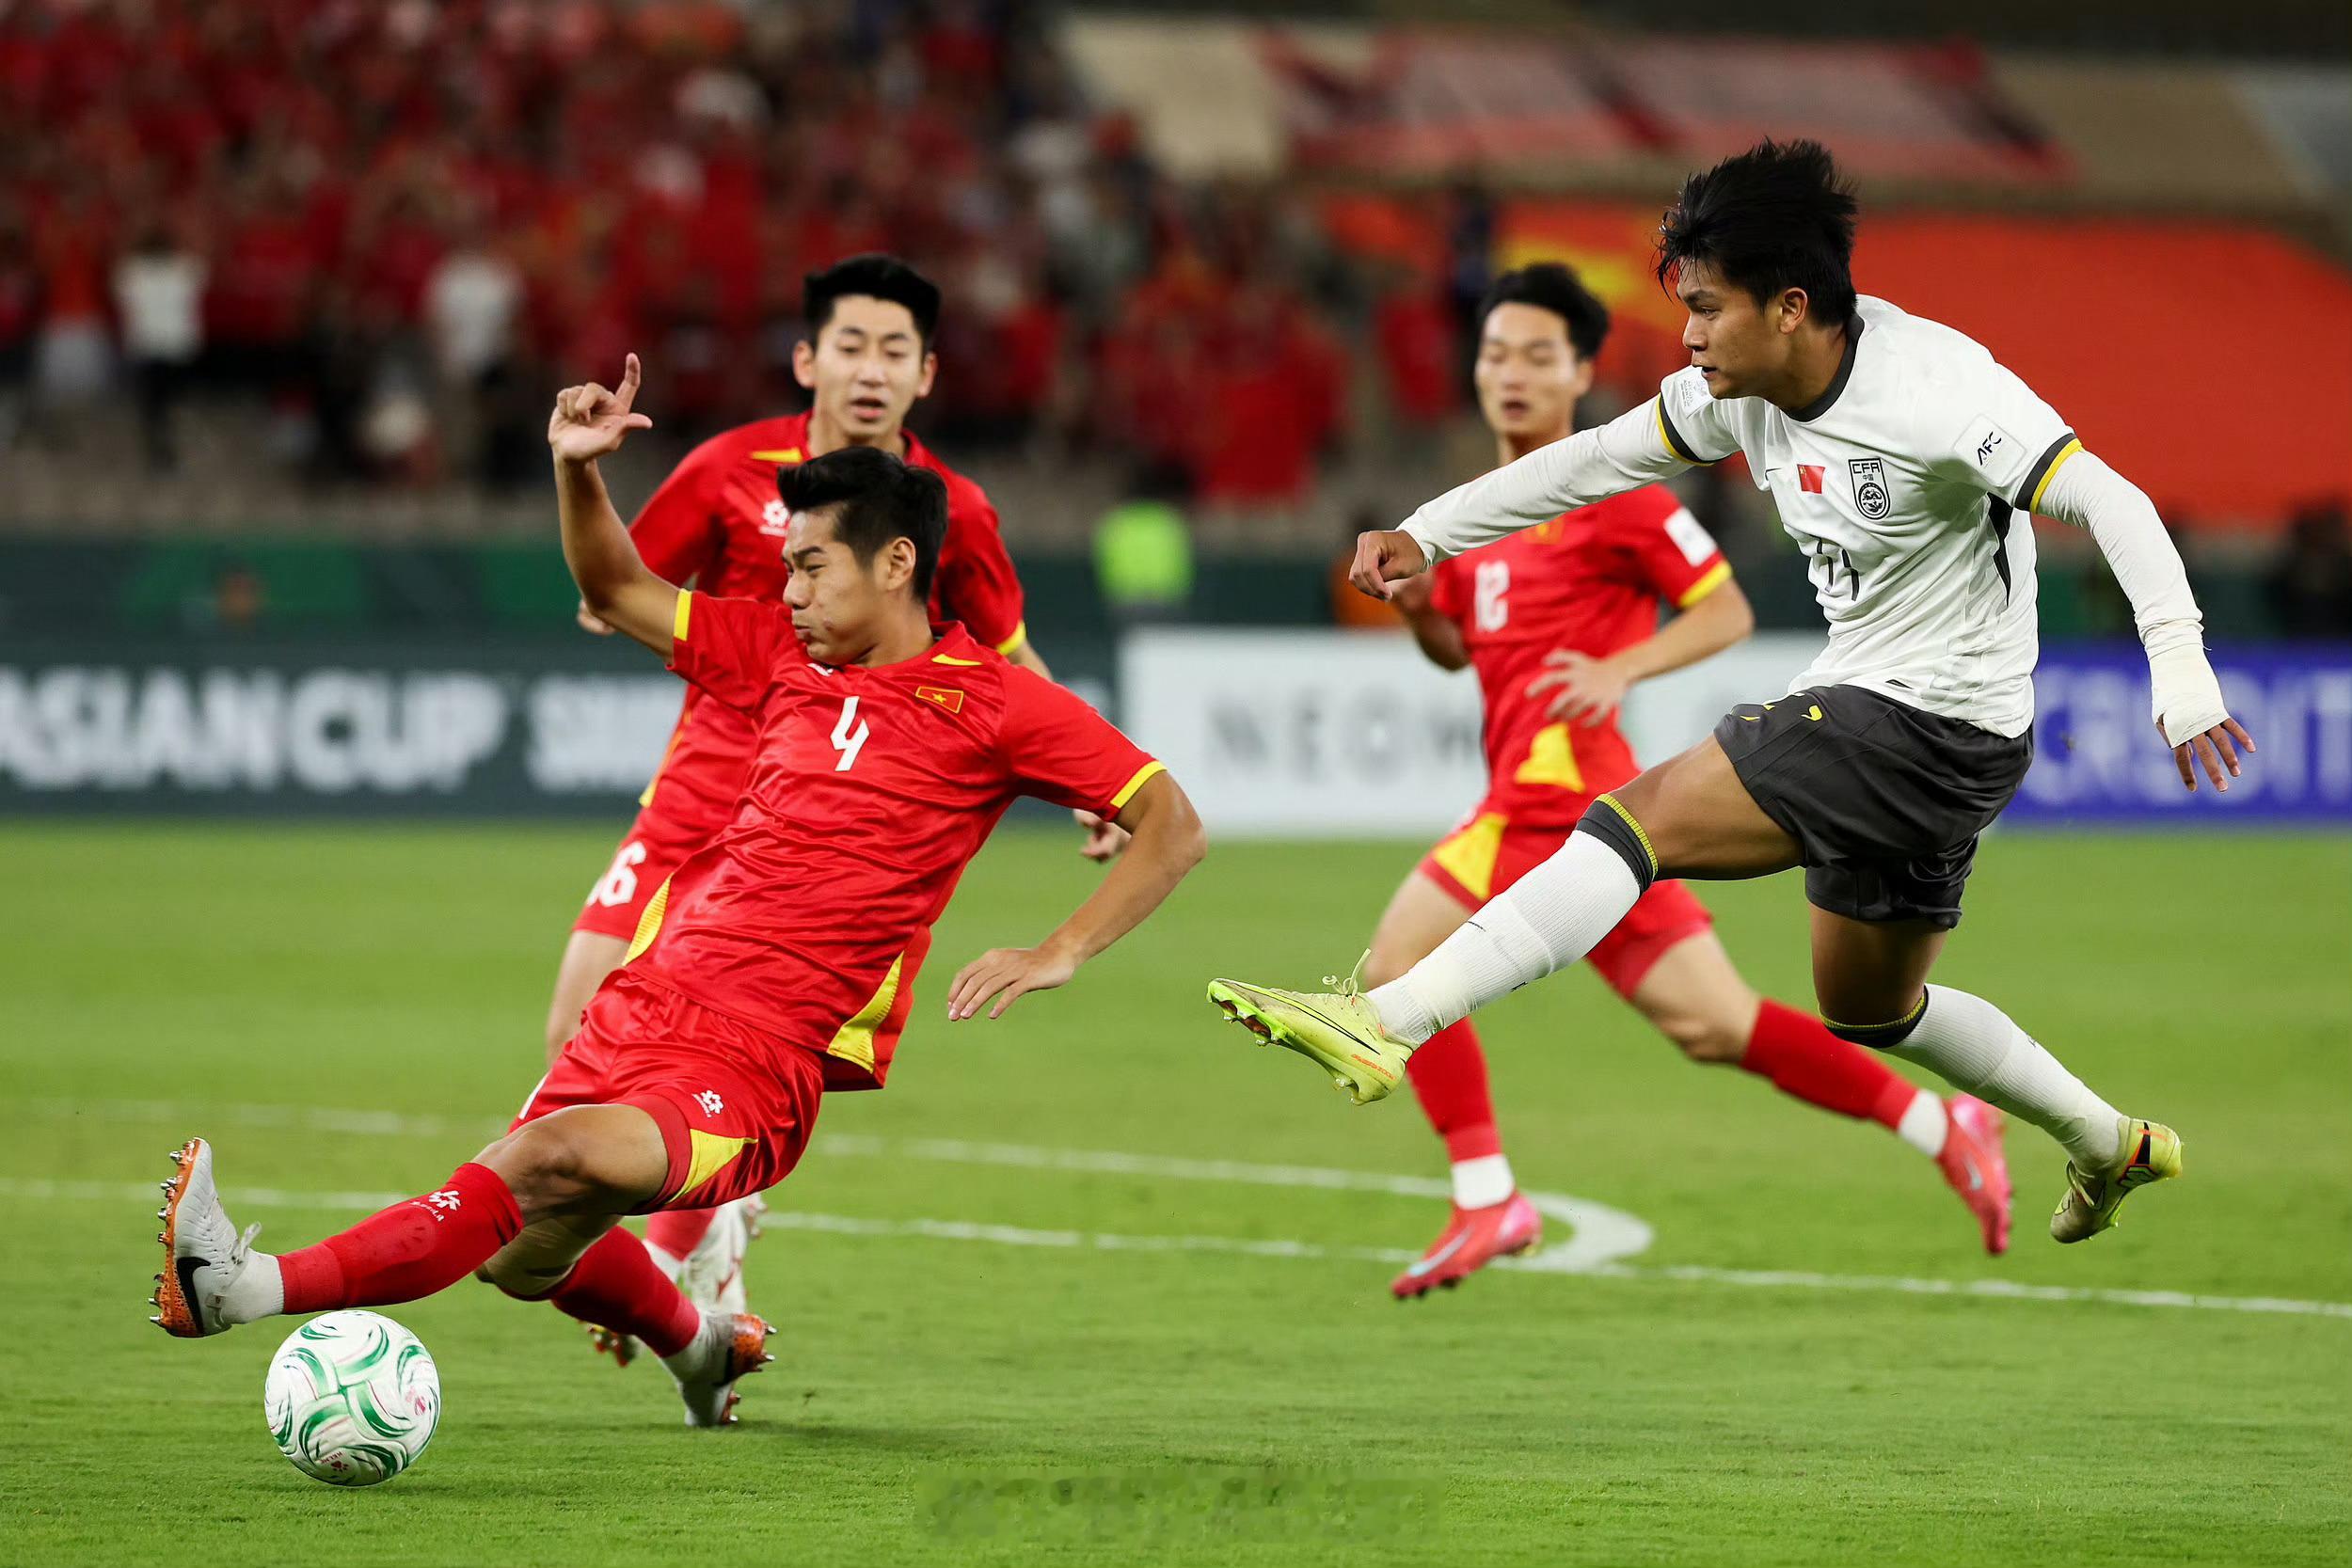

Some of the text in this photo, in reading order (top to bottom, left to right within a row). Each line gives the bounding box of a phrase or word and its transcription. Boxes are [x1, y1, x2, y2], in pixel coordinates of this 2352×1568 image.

[1851, 462, 1881, 474] CFA
[1978, 431, 2002, 466] AFC
[0, 663, 284, 791] ASIAN
[289, 666, 508, 791] CUP
[830, 695, 870, 771] 4
